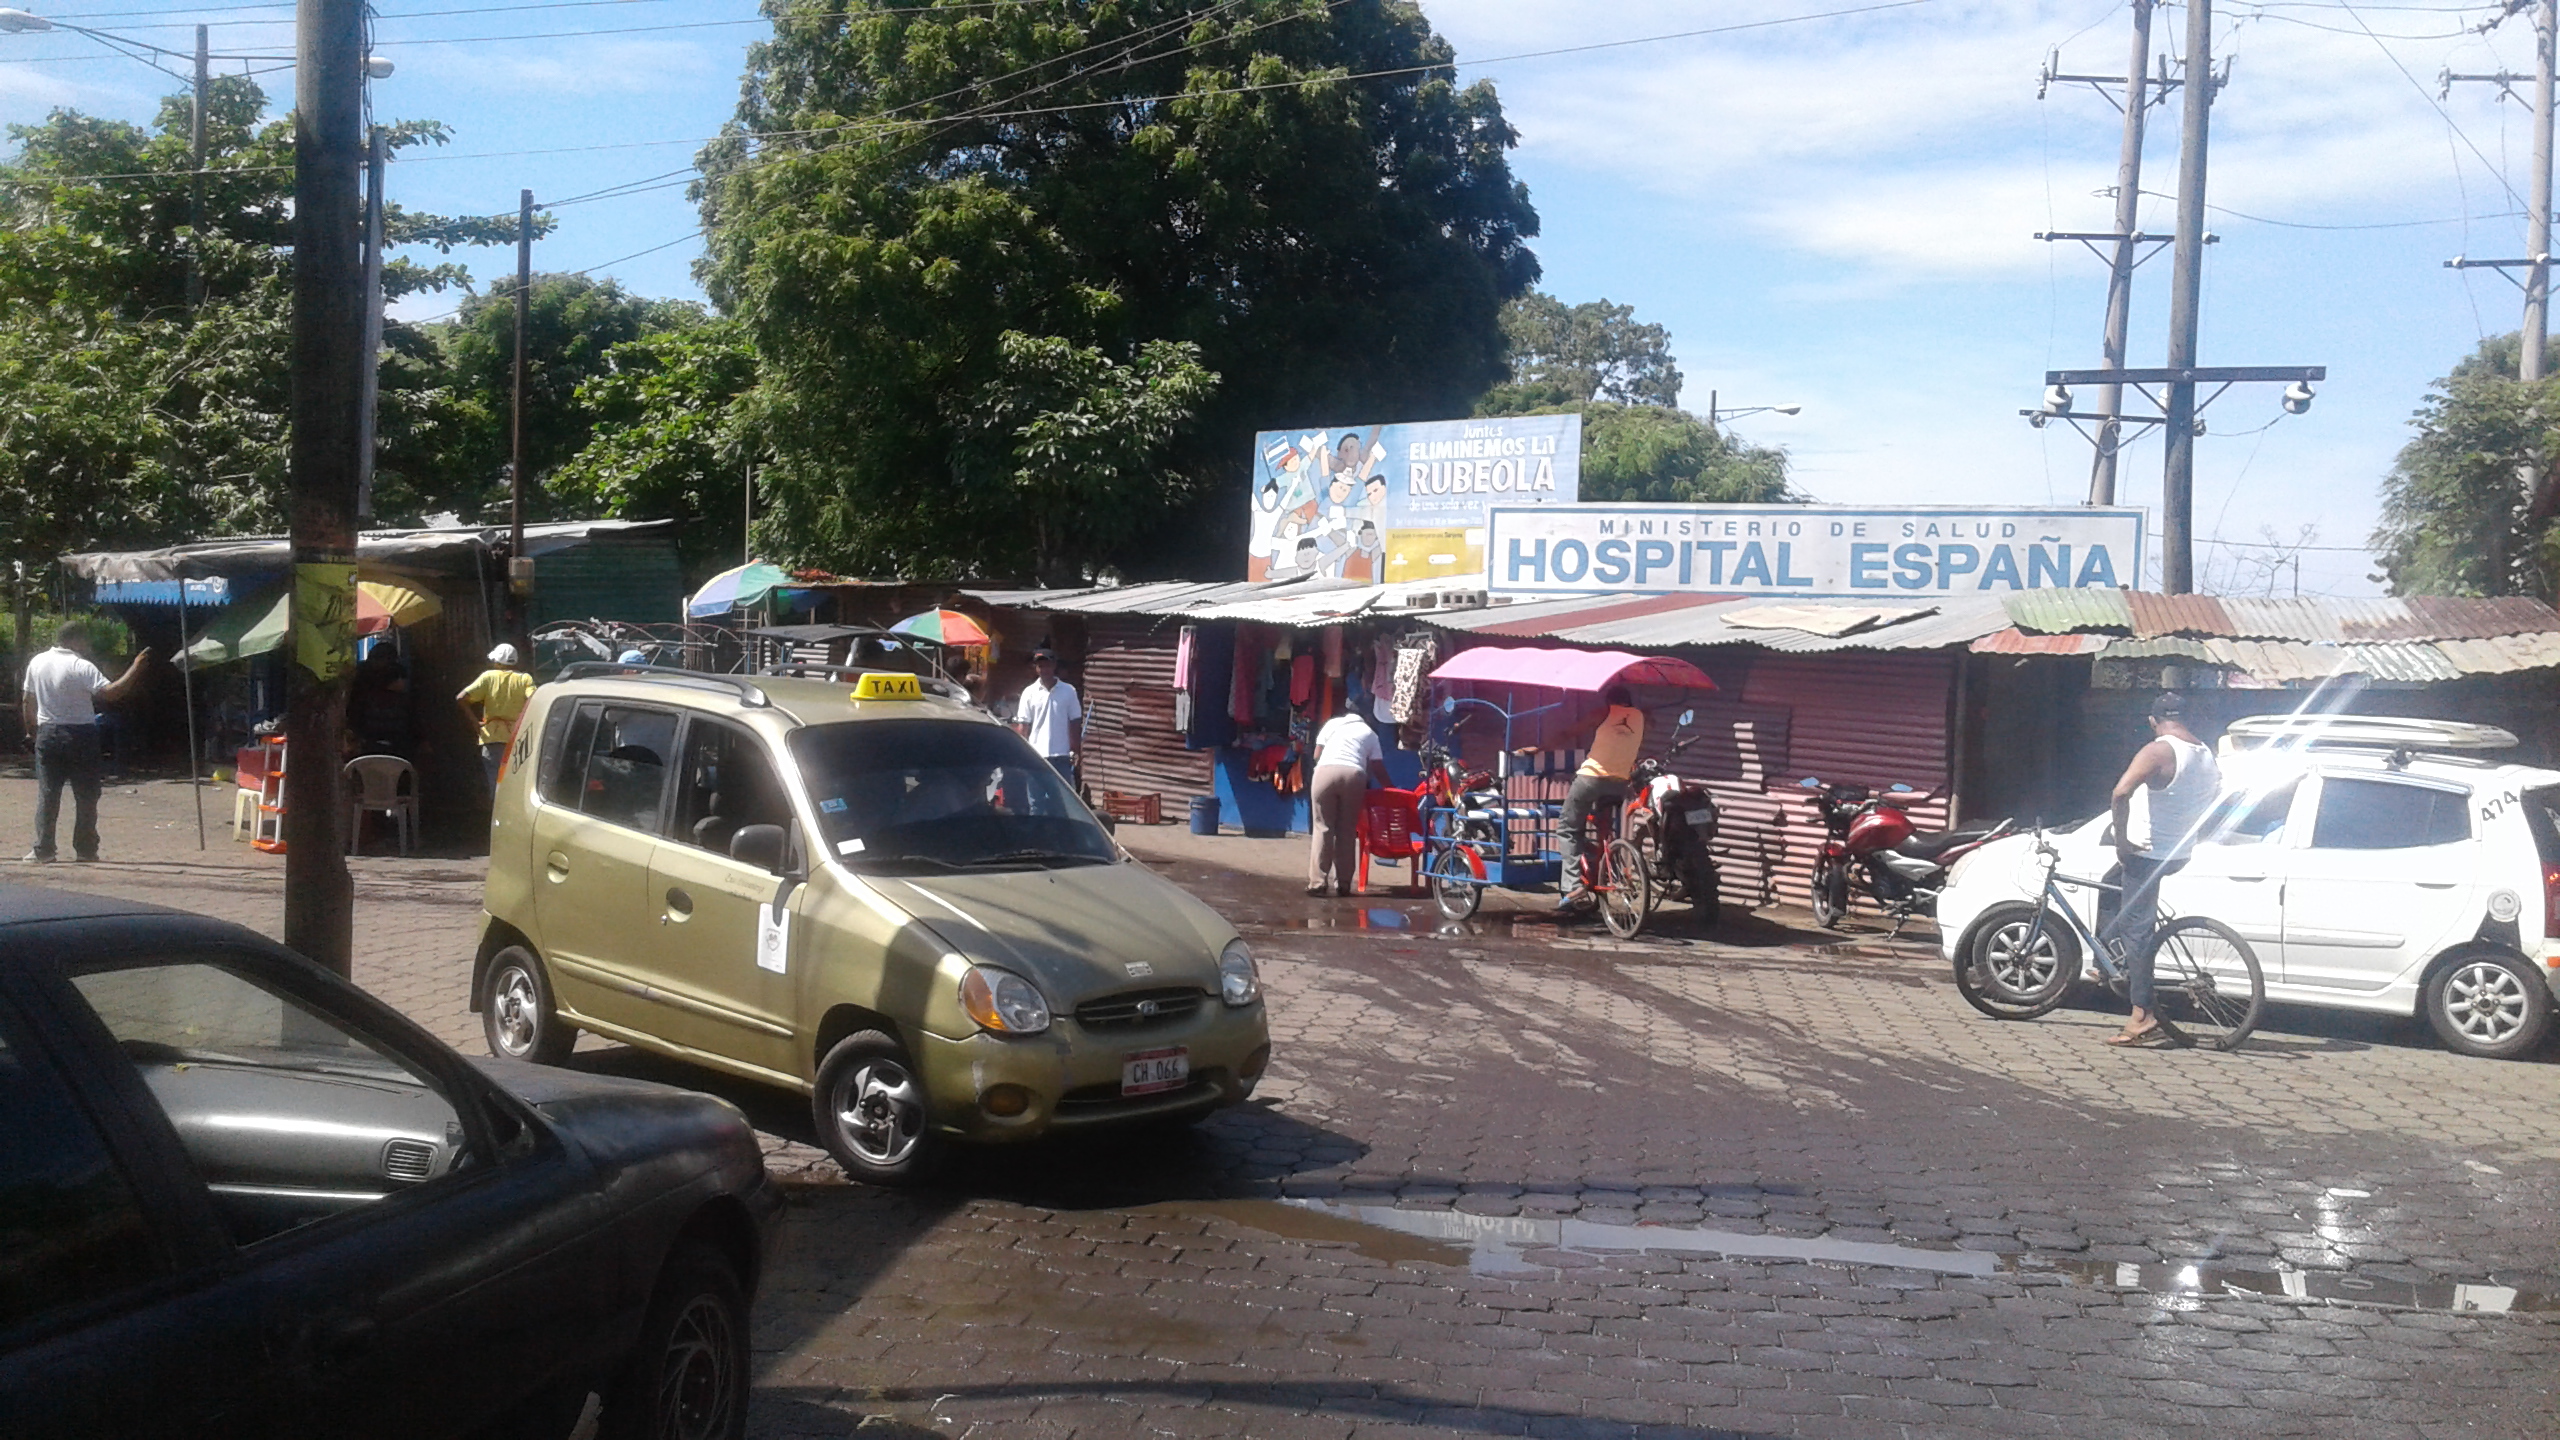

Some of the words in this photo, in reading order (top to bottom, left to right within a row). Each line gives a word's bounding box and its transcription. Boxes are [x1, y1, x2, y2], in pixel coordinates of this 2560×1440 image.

[1409, 436, 1526, 461] ELIMINEMOS
[1530, 434, 1556, 456] LA
[1408, 456, 1556, 496] RUBEOLA
[1599, 519, 1802, 538] MINISTERIO
[1829, 521, 1867, 538] DE
[1901, 521, 2017, 539] SALUD
[1507, 537, 1814, 588] HOSPITAL
[1850, 535, 2118, 590] ESPAÑA
[871, 680, 915, 694] TAXI
[2481, 790, 2520, 822] 474
[1133, 1062, 1150, 1084] CH
